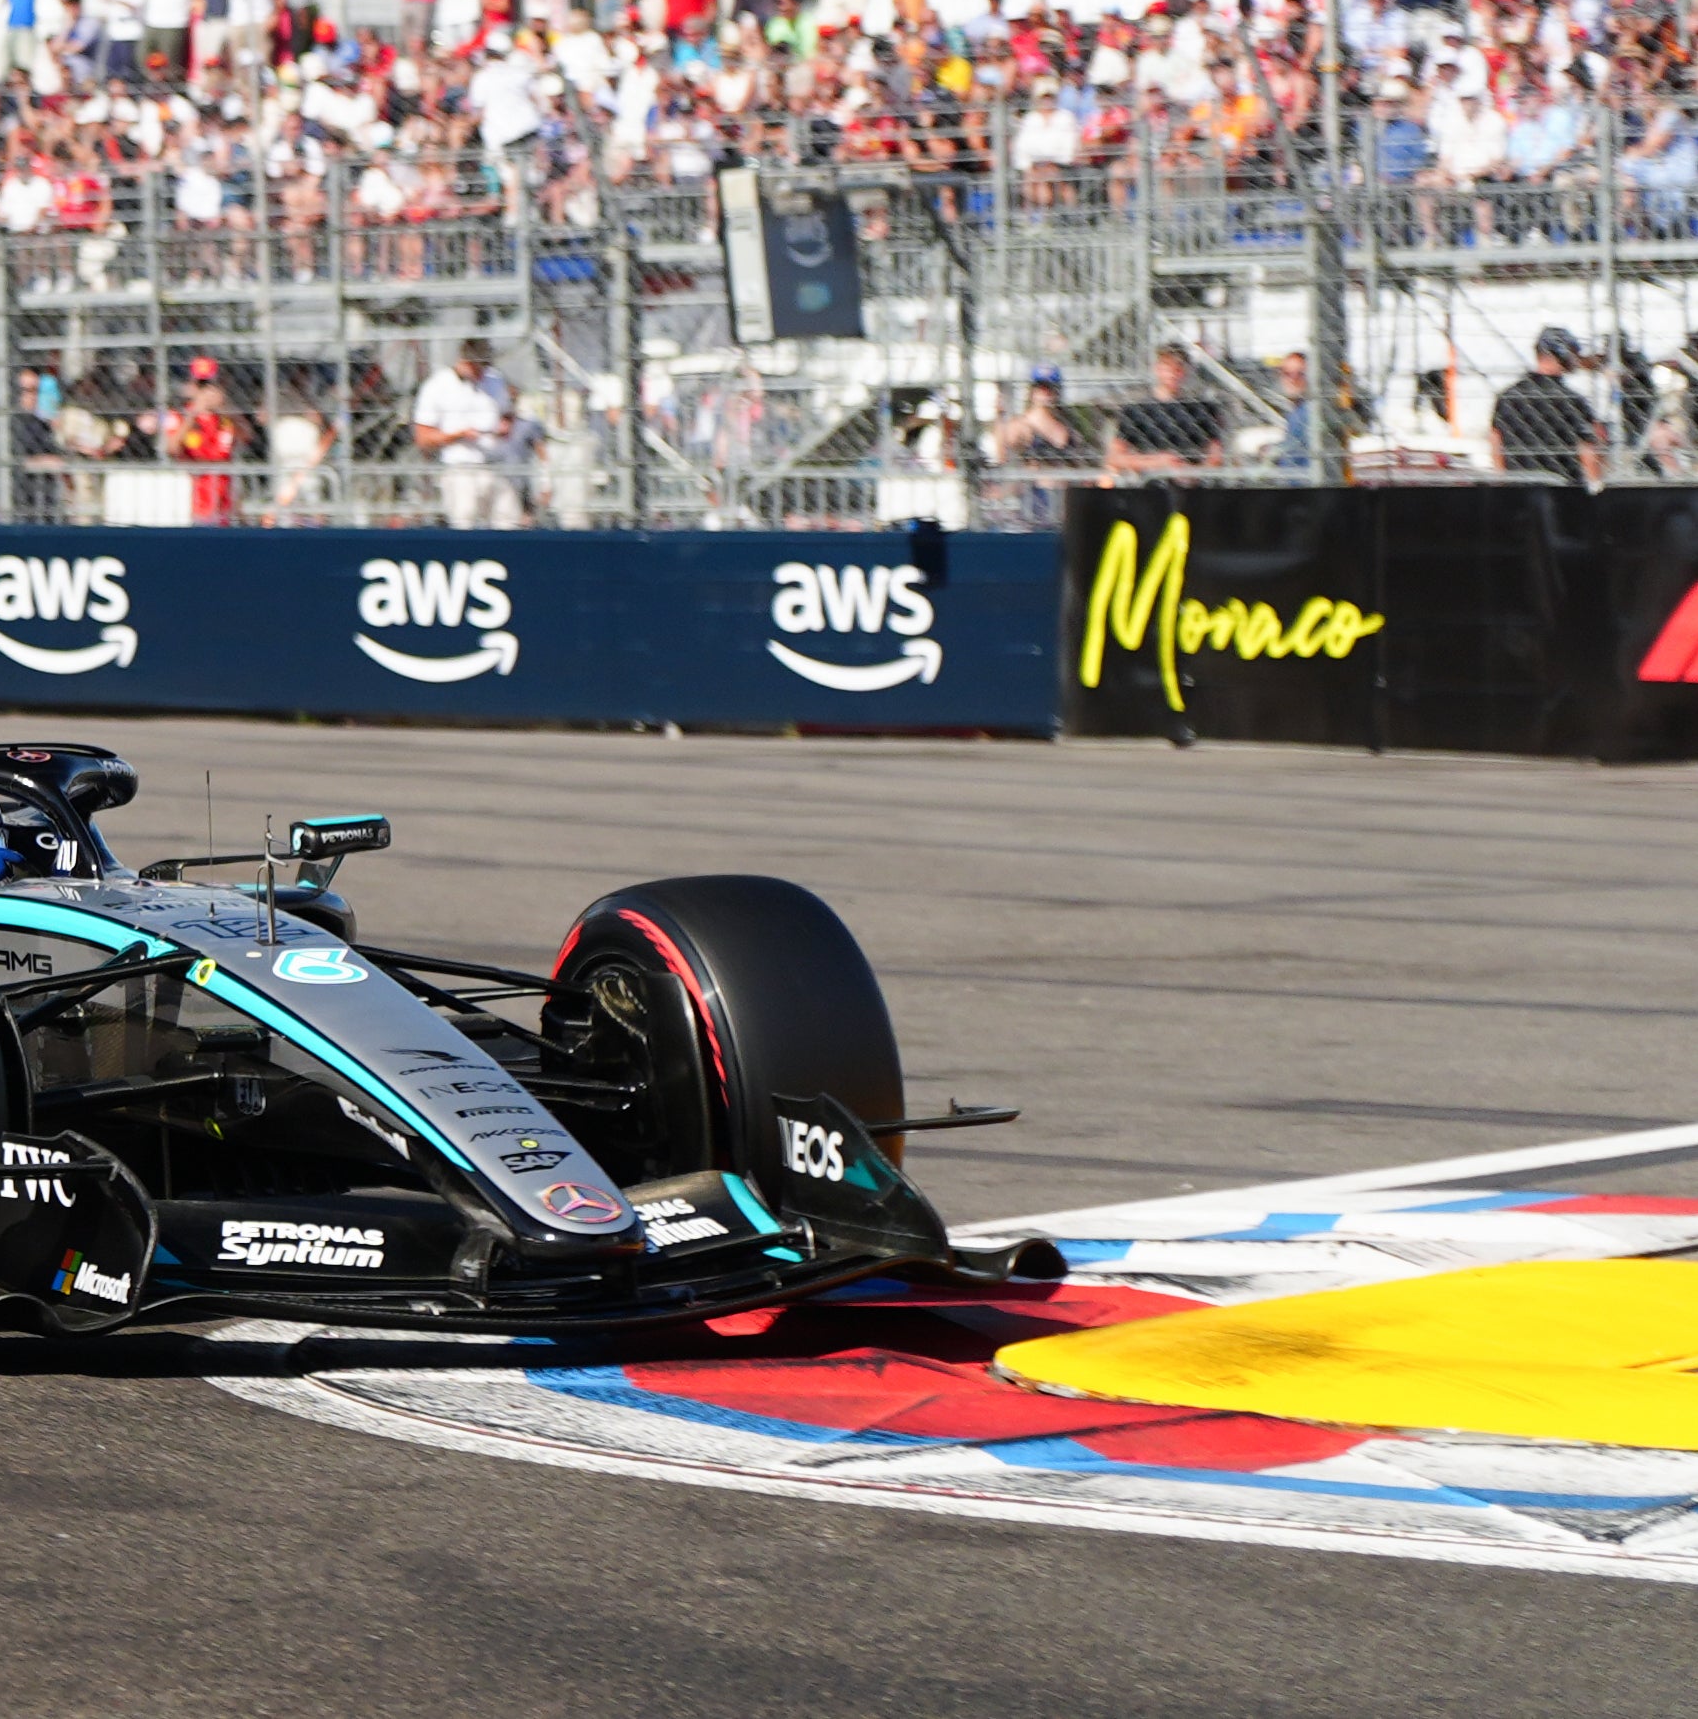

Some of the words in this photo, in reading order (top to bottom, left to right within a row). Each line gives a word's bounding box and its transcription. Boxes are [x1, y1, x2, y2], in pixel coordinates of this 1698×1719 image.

[359, 559, 512, 629] aws
[773, 562, 934, 636] aws
[1079, 512, 1386, 713] Monaco
[321, 828, 374, 845] PETRONAS
[417, 1081, 523, 1100] INEOS
[502, 1152, 564, 1172] SAP
[777, 1116, 844, 1182] INEOS
[0, 1141, 77, 1208] IWC
[217, 1237, 385, 1269] Syntium
[221, 1220, 385, 1246] PETRONAS
[74, 1261, 132, 1304] Microsoft
